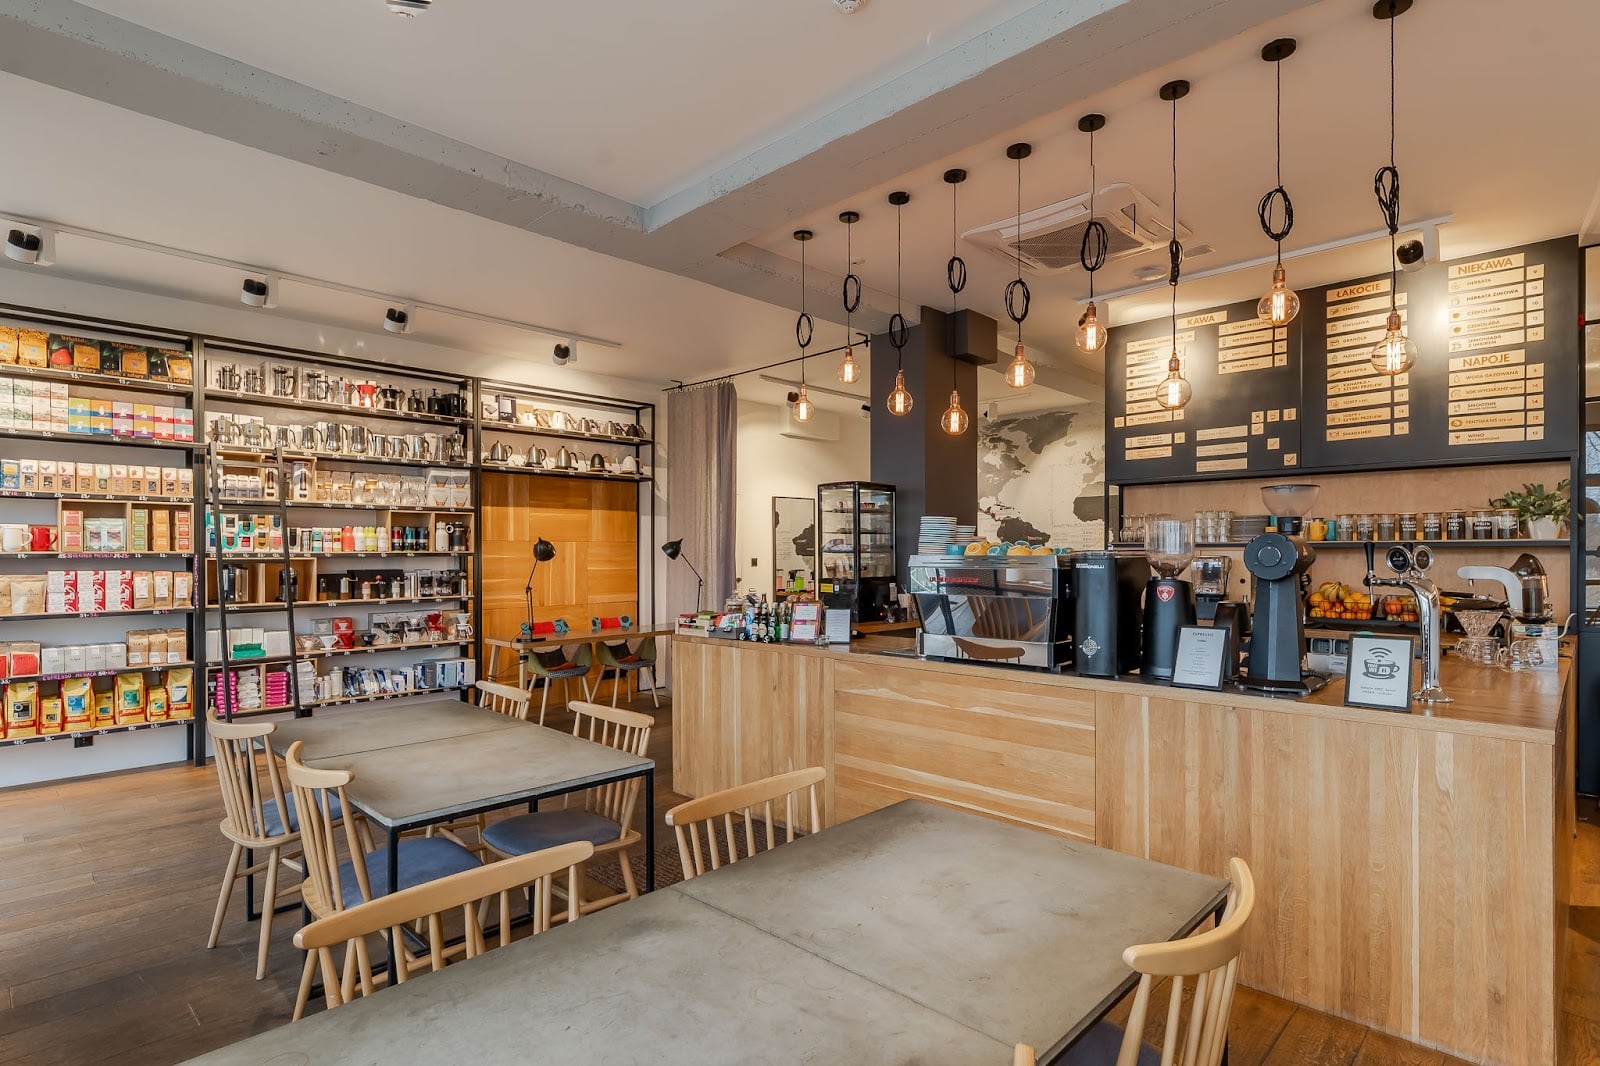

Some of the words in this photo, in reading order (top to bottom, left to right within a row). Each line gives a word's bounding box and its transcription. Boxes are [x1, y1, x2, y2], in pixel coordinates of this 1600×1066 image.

[1458, 258, 1513, 275] NIEKAWA
[1336, 283, 1381, 298] ŁAKOCIE
[1186, 314, 1216, 327] KAWA
[1463, 354, 1510, 367] NAPOJE
